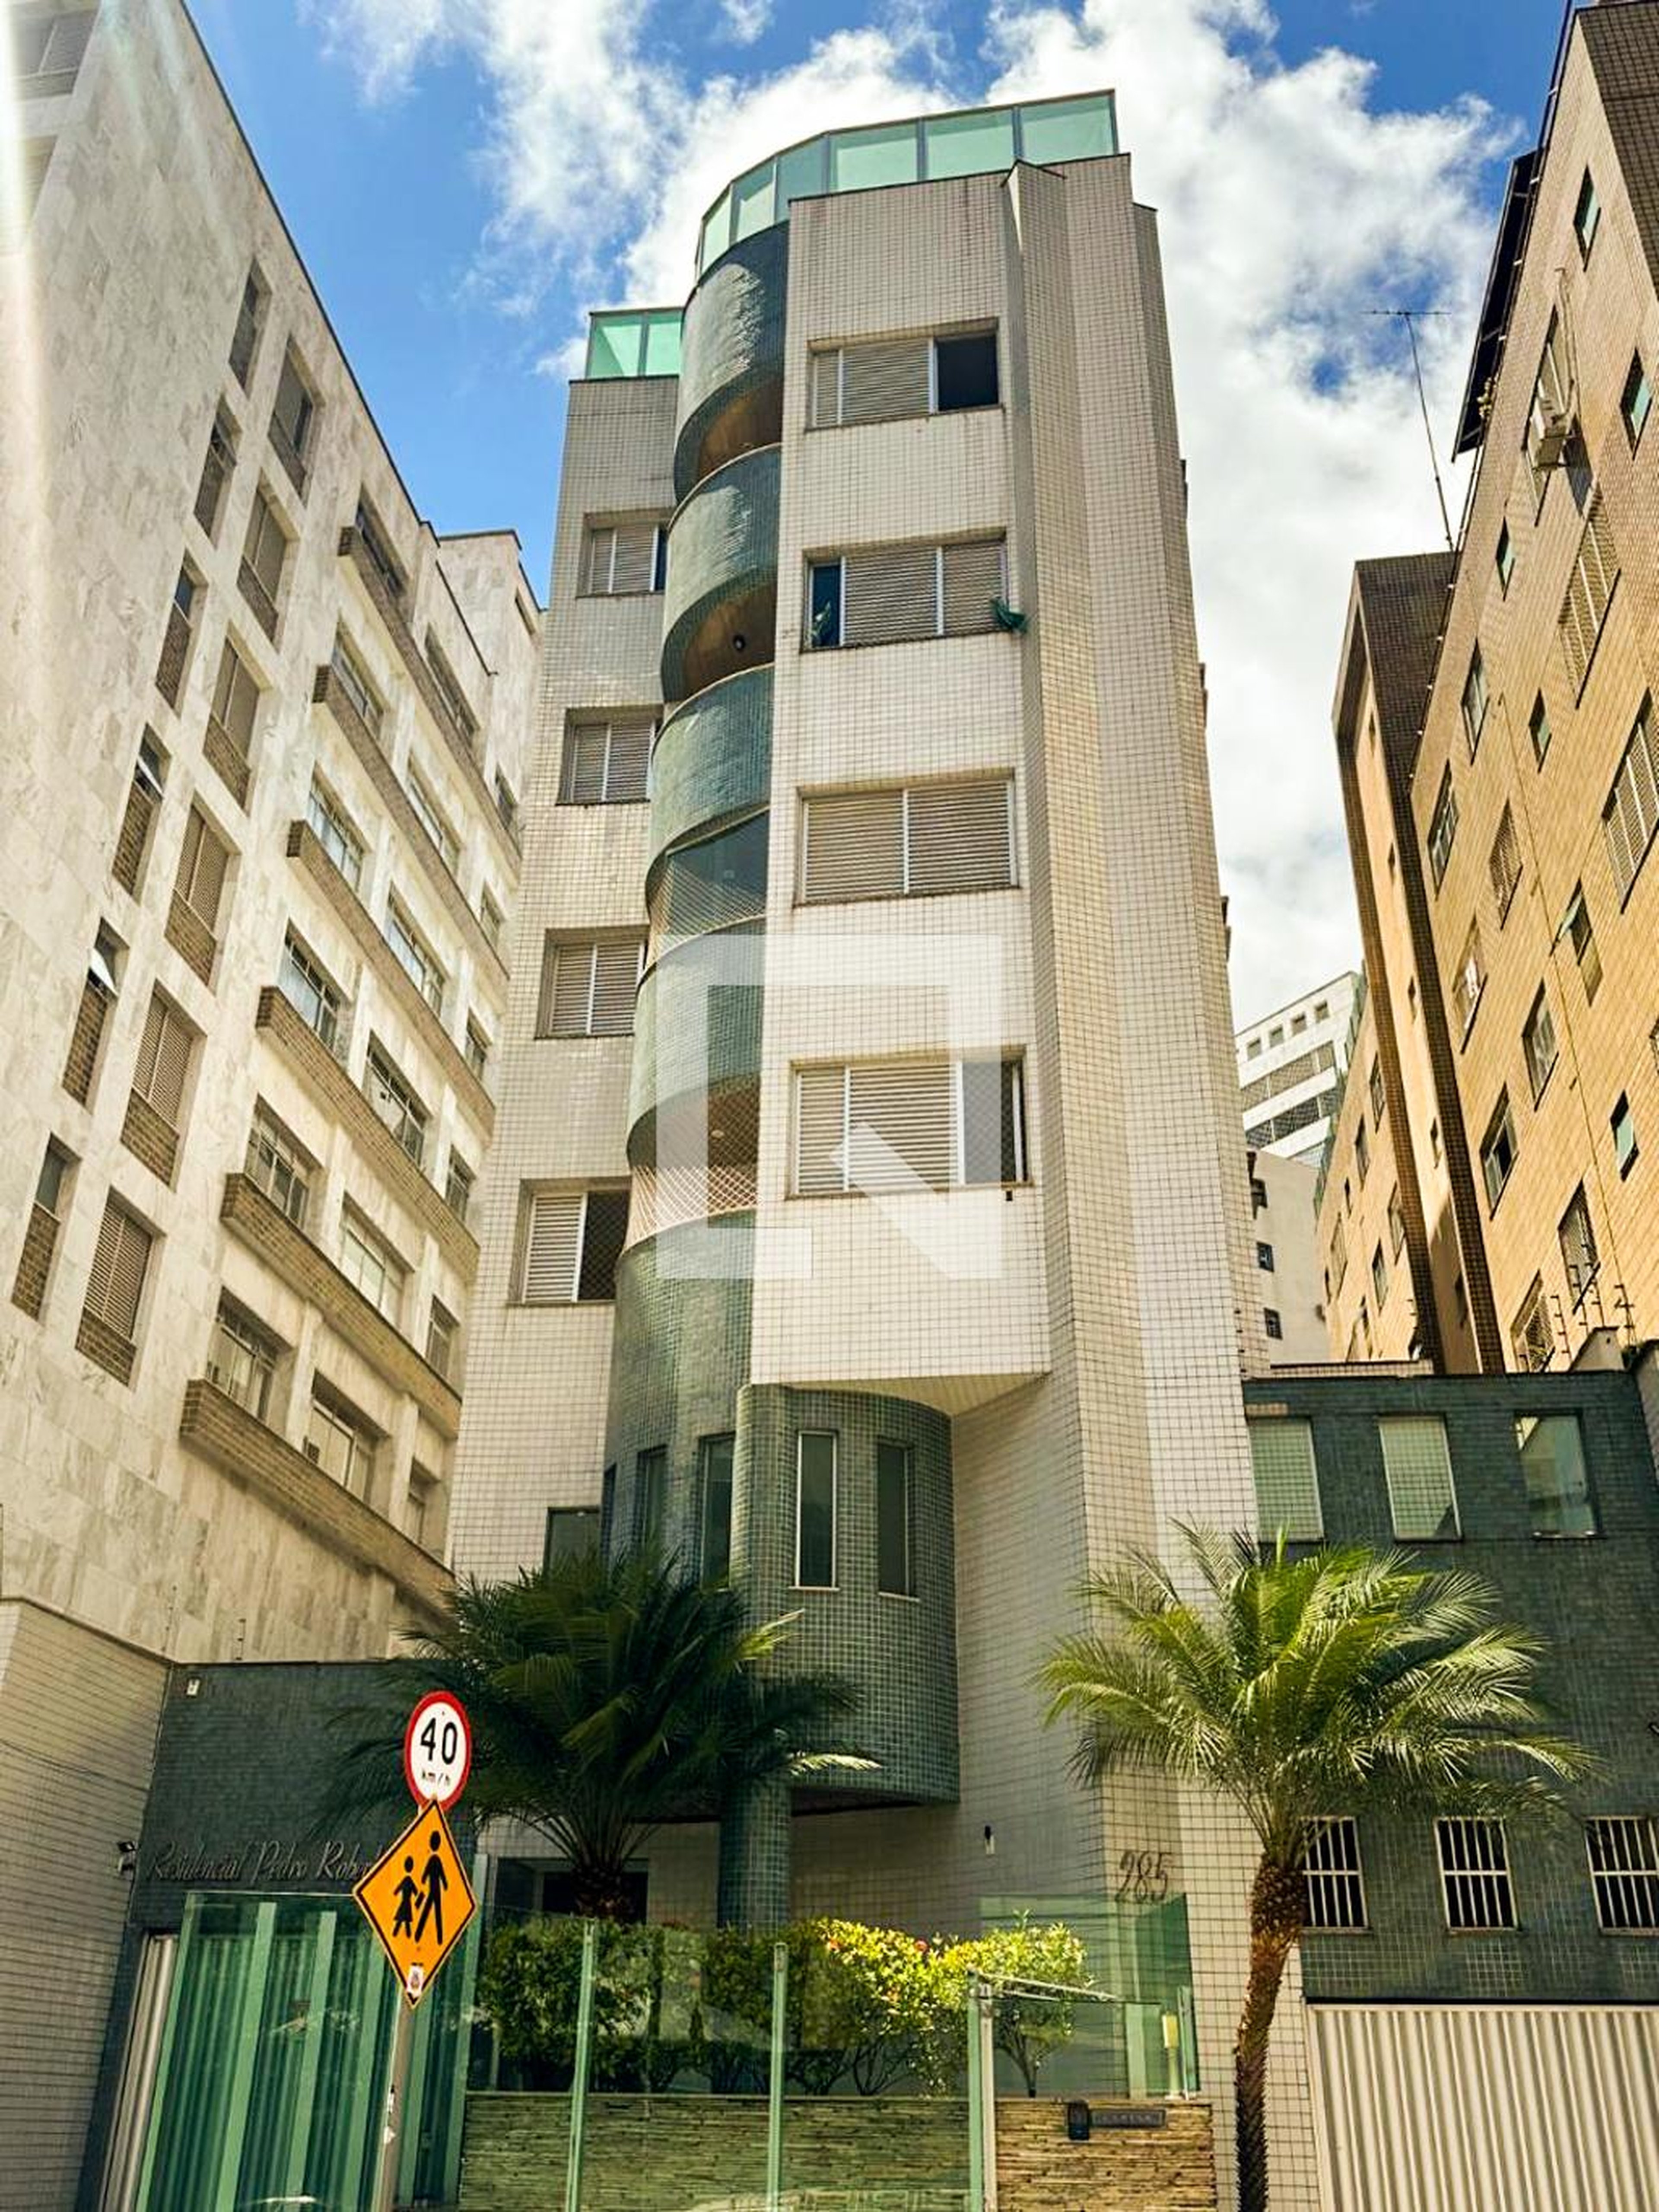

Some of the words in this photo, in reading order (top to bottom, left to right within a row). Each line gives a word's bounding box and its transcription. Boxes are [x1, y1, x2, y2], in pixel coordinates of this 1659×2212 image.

[420, 1717, 458, 1765] 40
[250, 1840, 307, 1885] Pedro
[1114, 1851, 1169, 1903] 285
